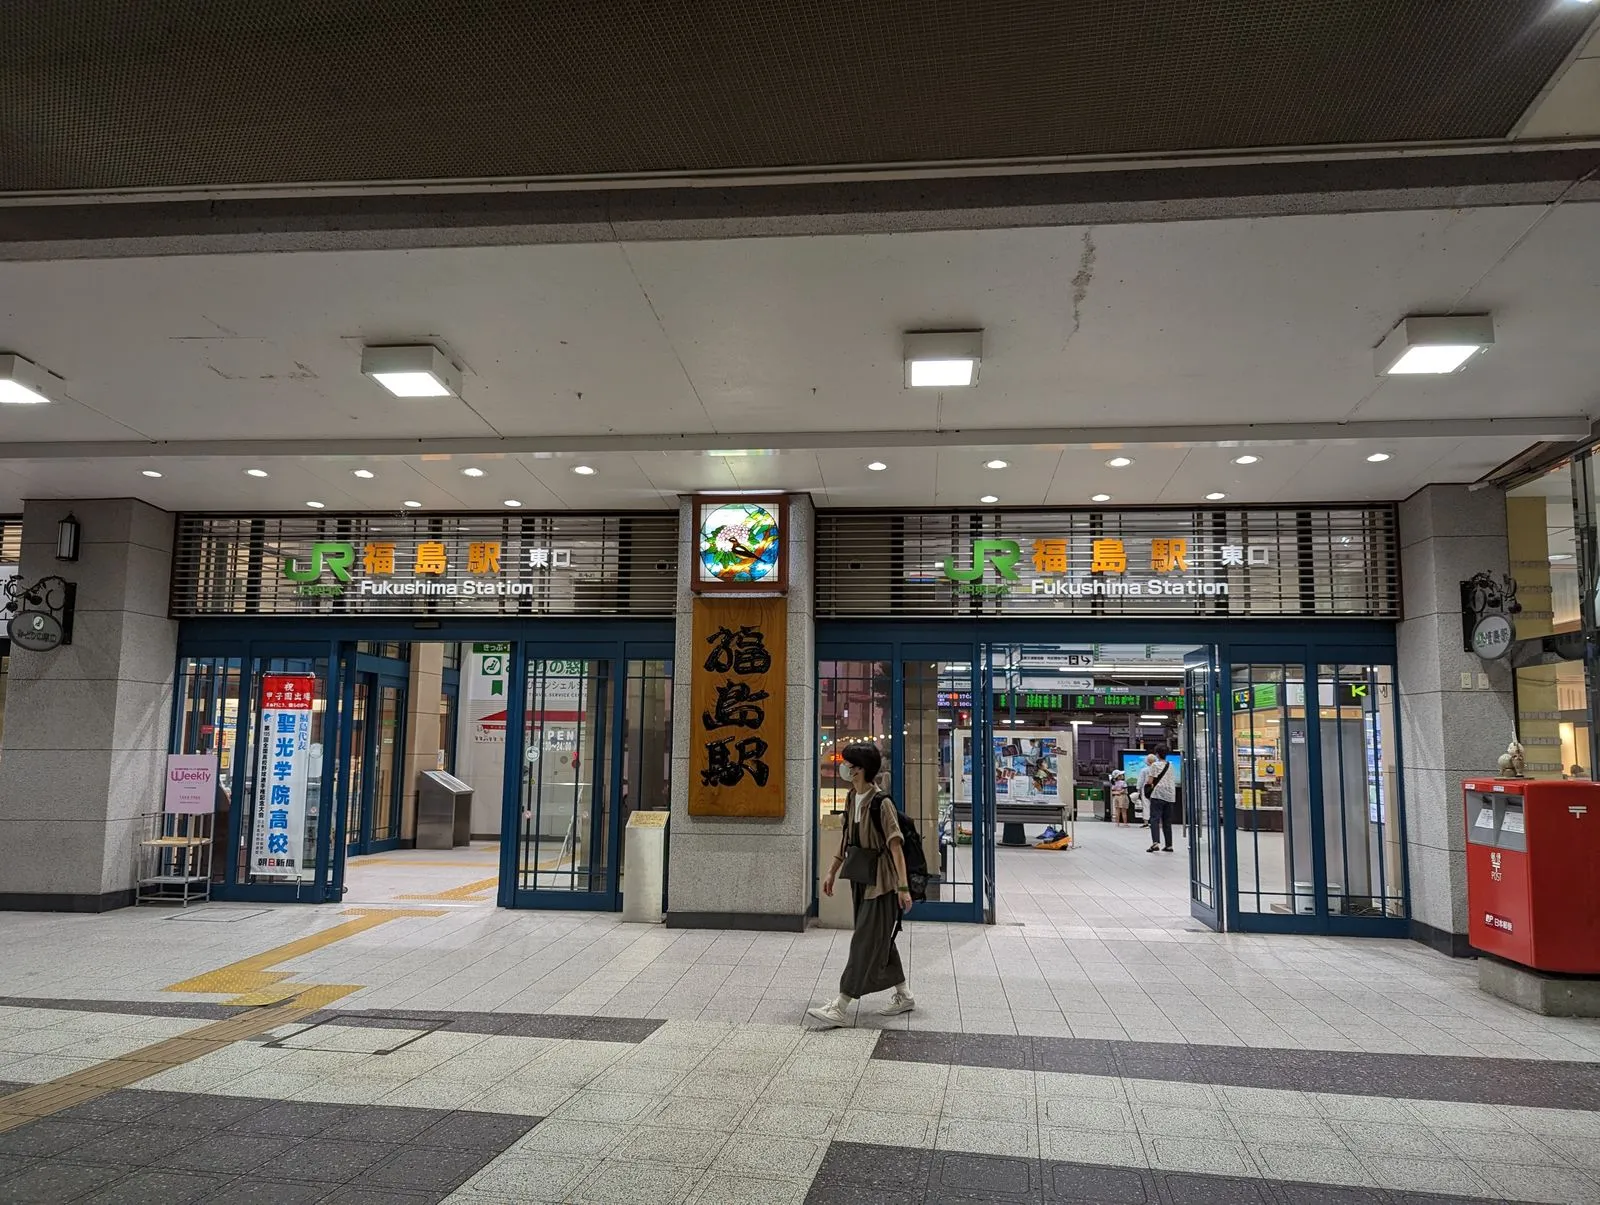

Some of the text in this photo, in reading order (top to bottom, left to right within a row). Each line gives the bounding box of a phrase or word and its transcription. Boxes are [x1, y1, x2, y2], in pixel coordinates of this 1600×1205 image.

[284, 540, 572, 582] JR 福島駅 東口
[944, 537, 1270, 580] JR 福島駅 東口
[360, 580, 533, 595] Fukushima Station
[1031, 579, 1229, 595] Fukushima Station
[701, 625, 772, 787] 福島駅
[170, 771, 212, 783] Weekly
[267, 713, 297, 854] 聖光学院高校
[257, 858, 296, 868] 朝日新聞
